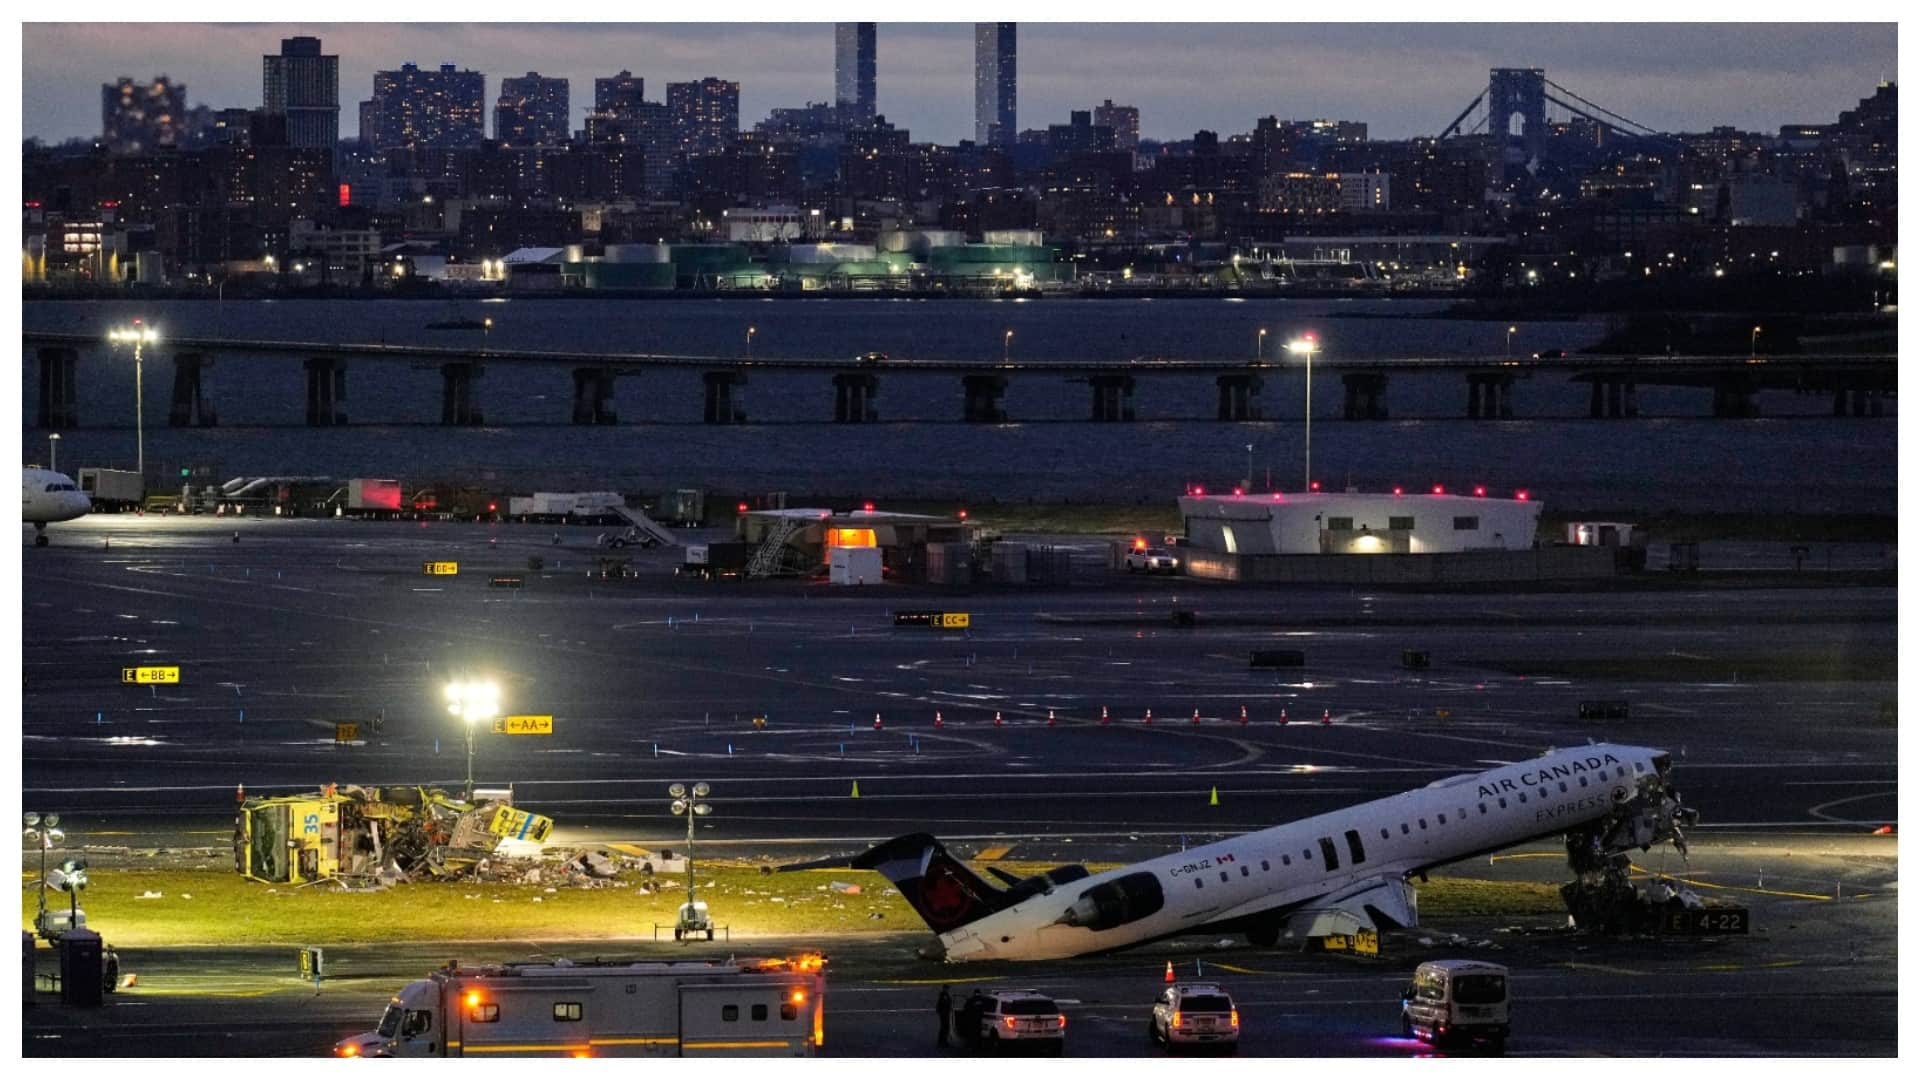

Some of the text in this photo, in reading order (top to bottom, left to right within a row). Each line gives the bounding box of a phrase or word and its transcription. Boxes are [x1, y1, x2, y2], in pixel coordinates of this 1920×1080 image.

[945, 615, 958, 625] CC
[151, 670, 166, 680] BB
[521, 719, 539, 730] AA
[1478, 753, 1620, 798] AIR CANADA
[1536, 793, 1606, 822] EXPRESS
[304, 814, 319, 834] 35
[1672, 914, 1741, 929] E 4-22
